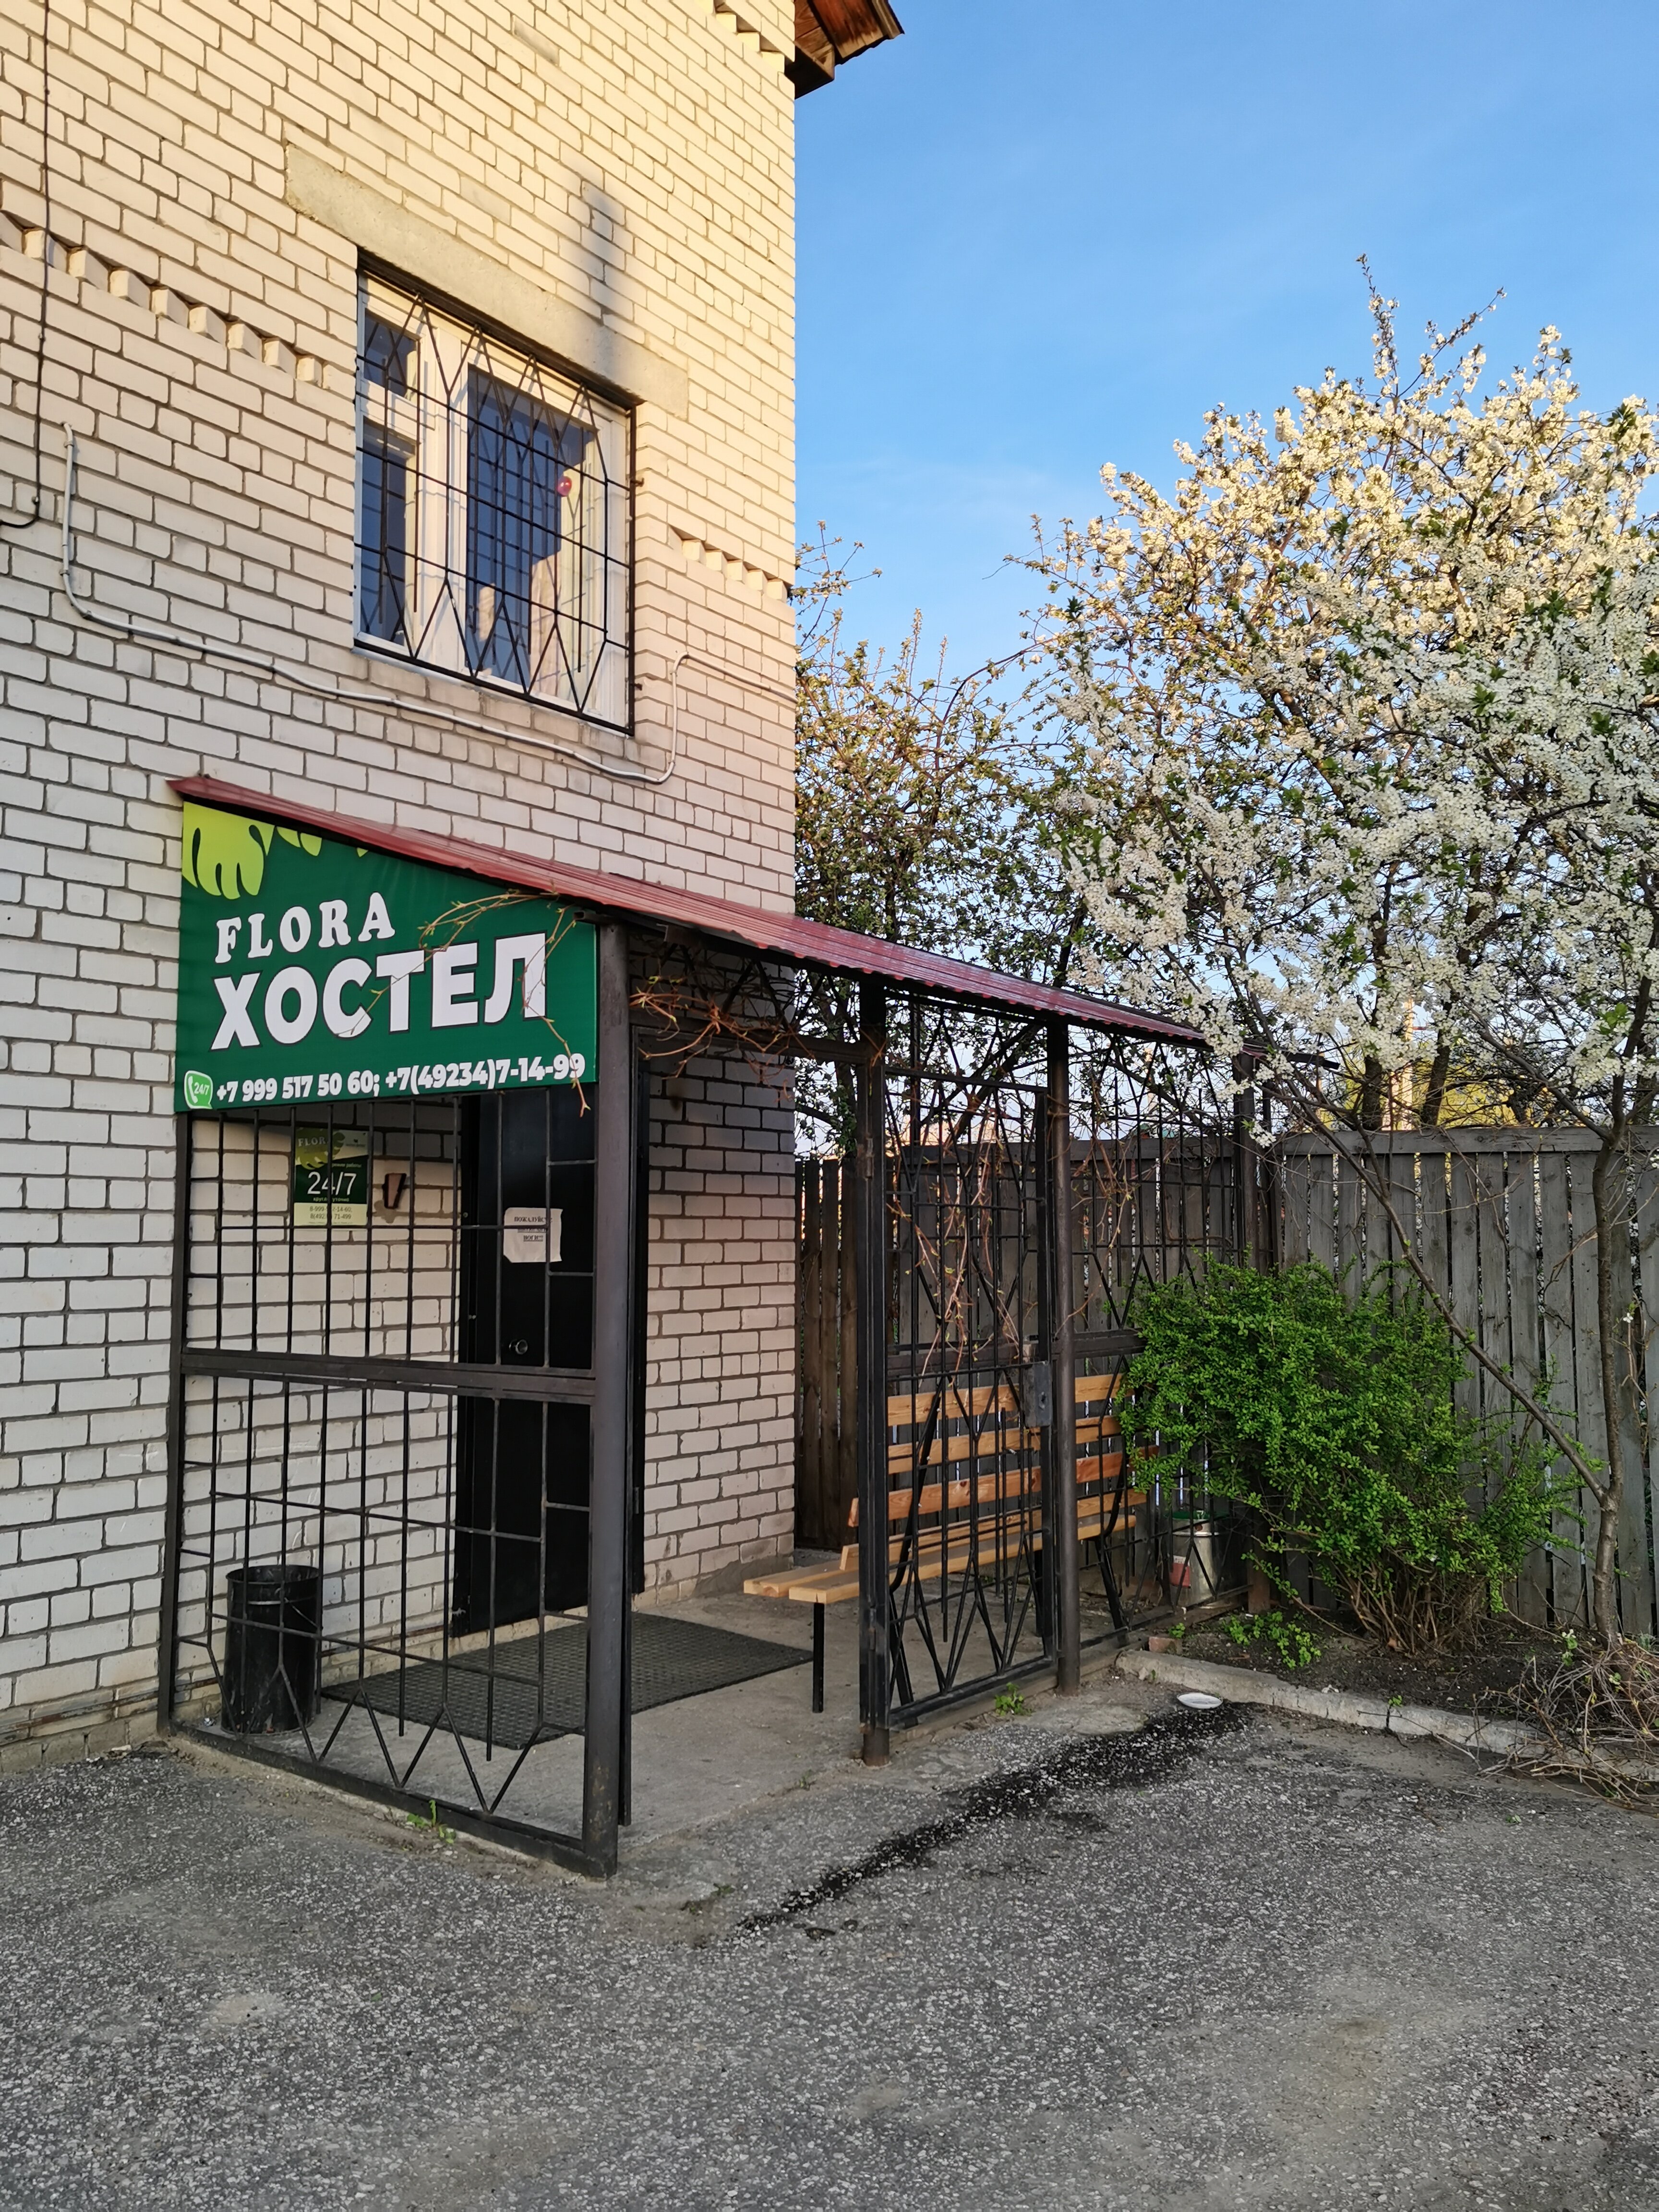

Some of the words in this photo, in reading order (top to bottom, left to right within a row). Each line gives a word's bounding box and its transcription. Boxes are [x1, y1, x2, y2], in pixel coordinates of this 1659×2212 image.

[215, 891, 396, 963] FLORA
[210, 932, 547, 1051] ХОСТЕЛ
[193, 1082, 210, 1096] 24/7
[216, 1081, 239, 1103] +7
[242, 1078, 277, 1102] 999
[281, 1075, 313, 1099] 517
[317, 1072, 343, 1097] 50
[347, 1070, 380, 1097] 60;
[385, 1053, 586, 1095] +7(49234)7-14-99
[298, 1136, 329, 1147] FLOR
[307, 1171, 357, 1196] 24/7
